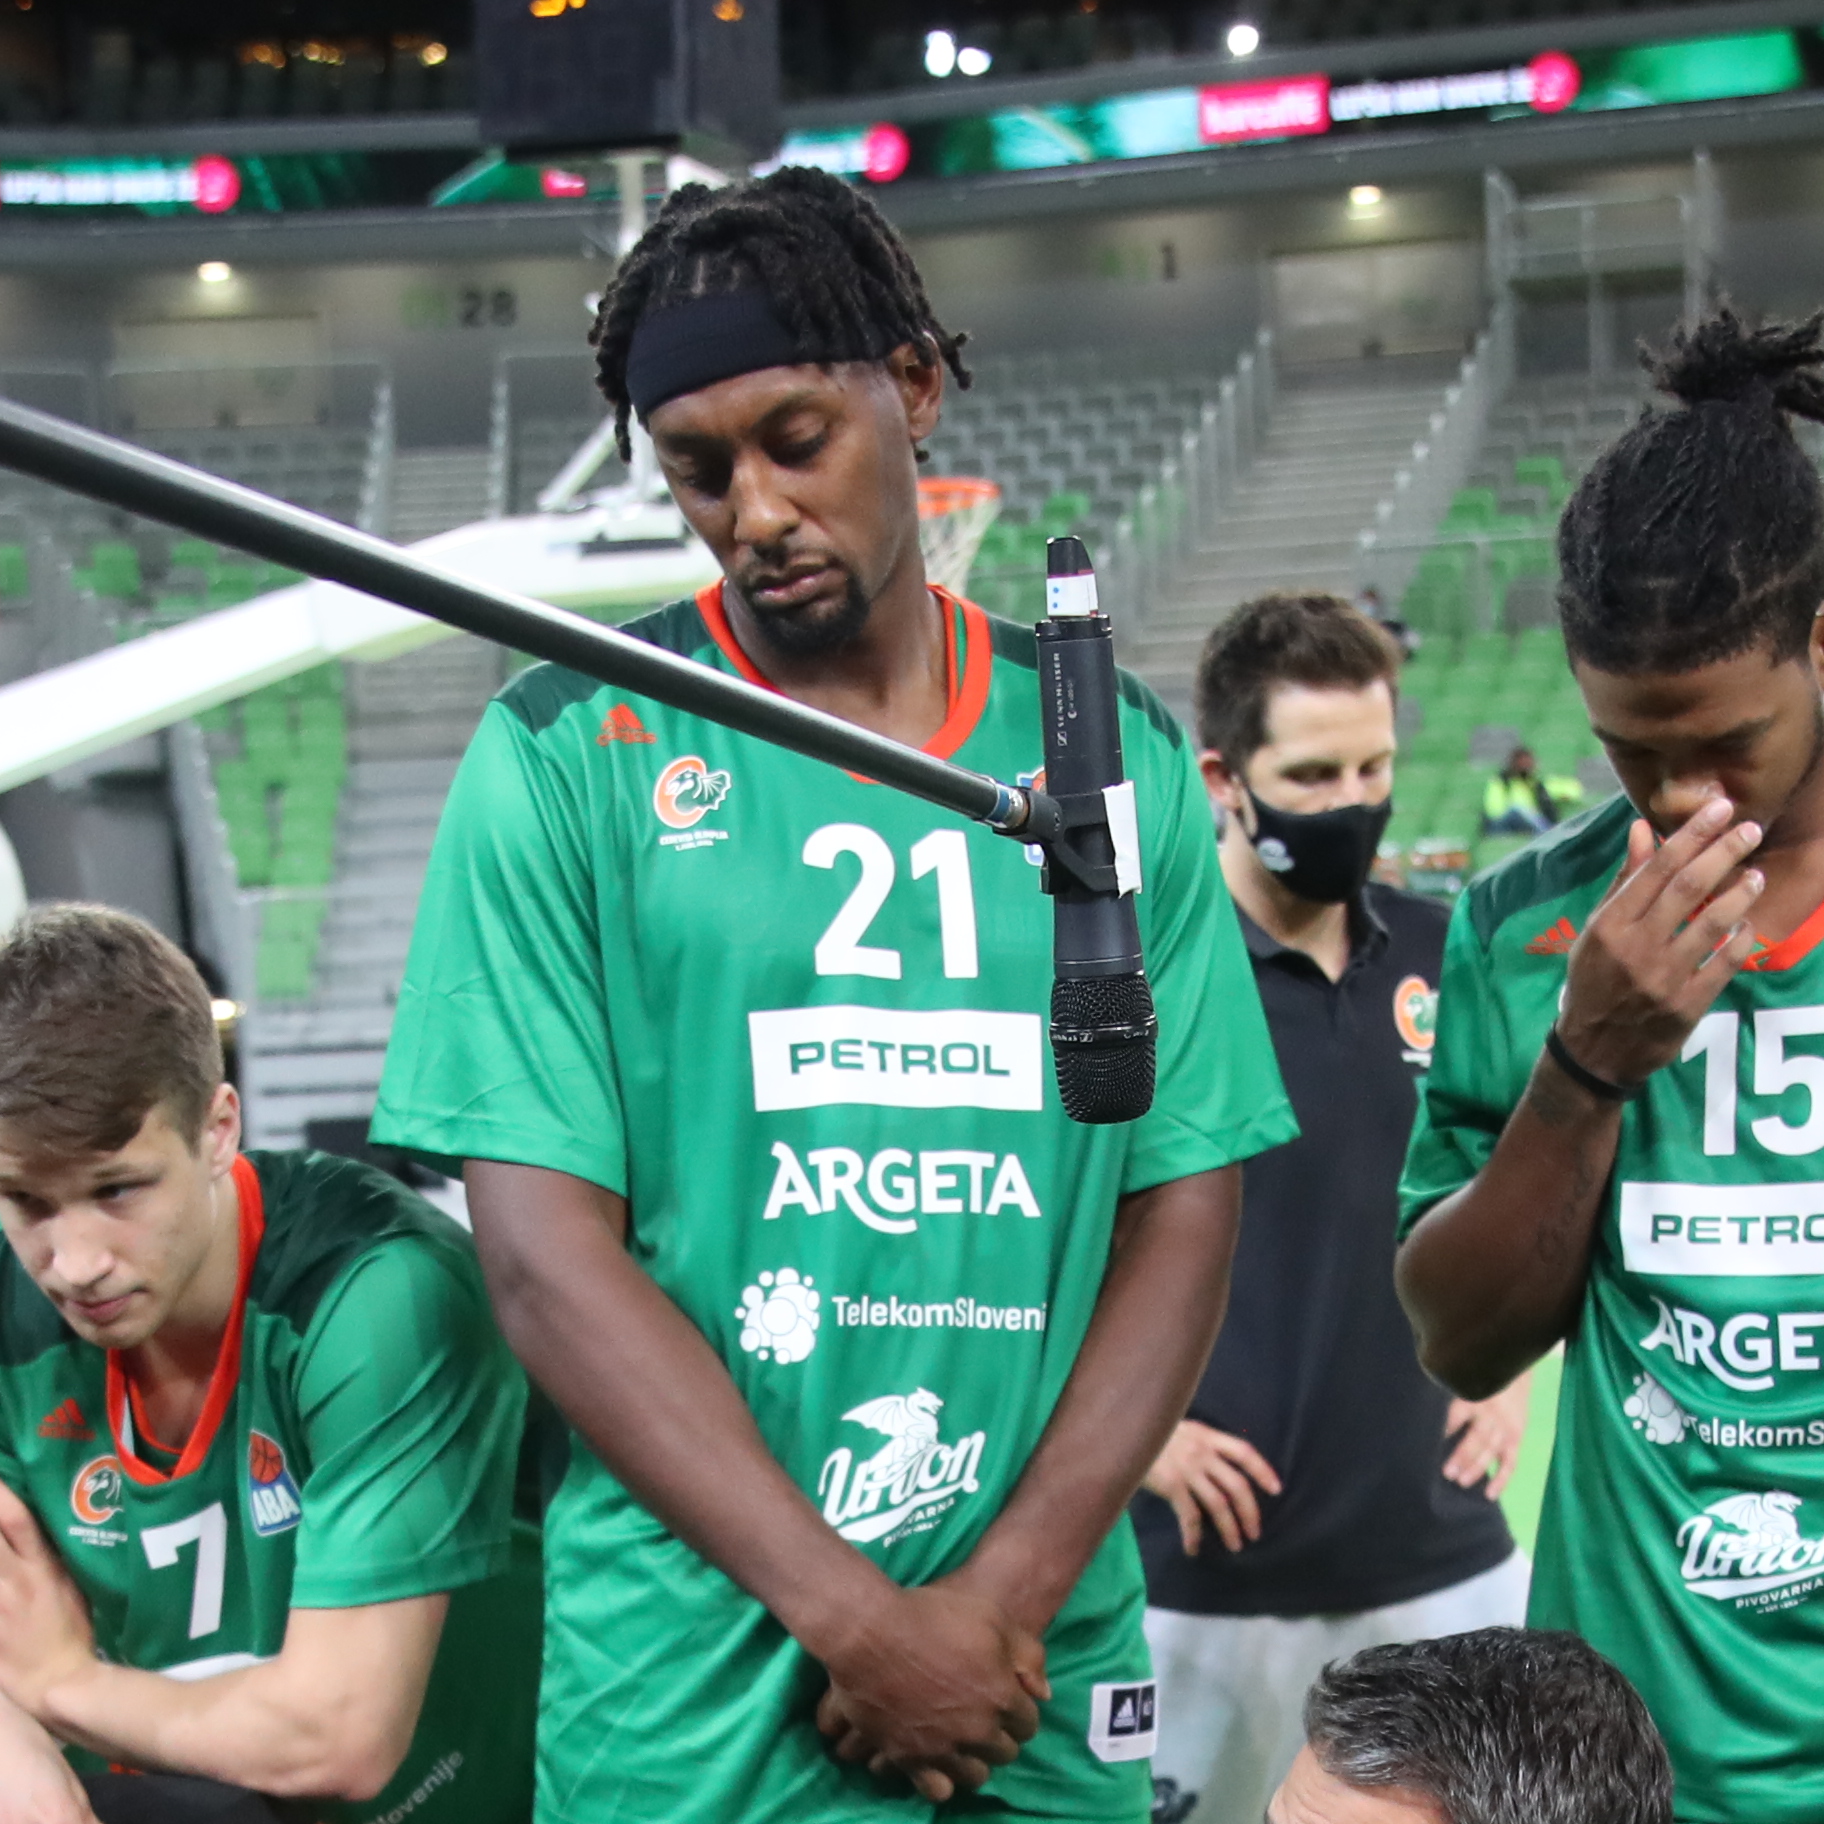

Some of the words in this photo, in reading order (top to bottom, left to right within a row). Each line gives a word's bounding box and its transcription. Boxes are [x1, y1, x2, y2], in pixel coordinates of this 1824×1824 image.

[802, 822, 979, 980] 21
[790, 1038, 1011, 1077] PETROL
[763, 1141, 1042, 1234] ARGETA
[253, 1484, 300, 1526] ABA
[817, 1430, 987, 1532] Union
[140, 1502, 228, 1640] 7
[1736, 1577, 1824, 1609] PIVOVARNA
